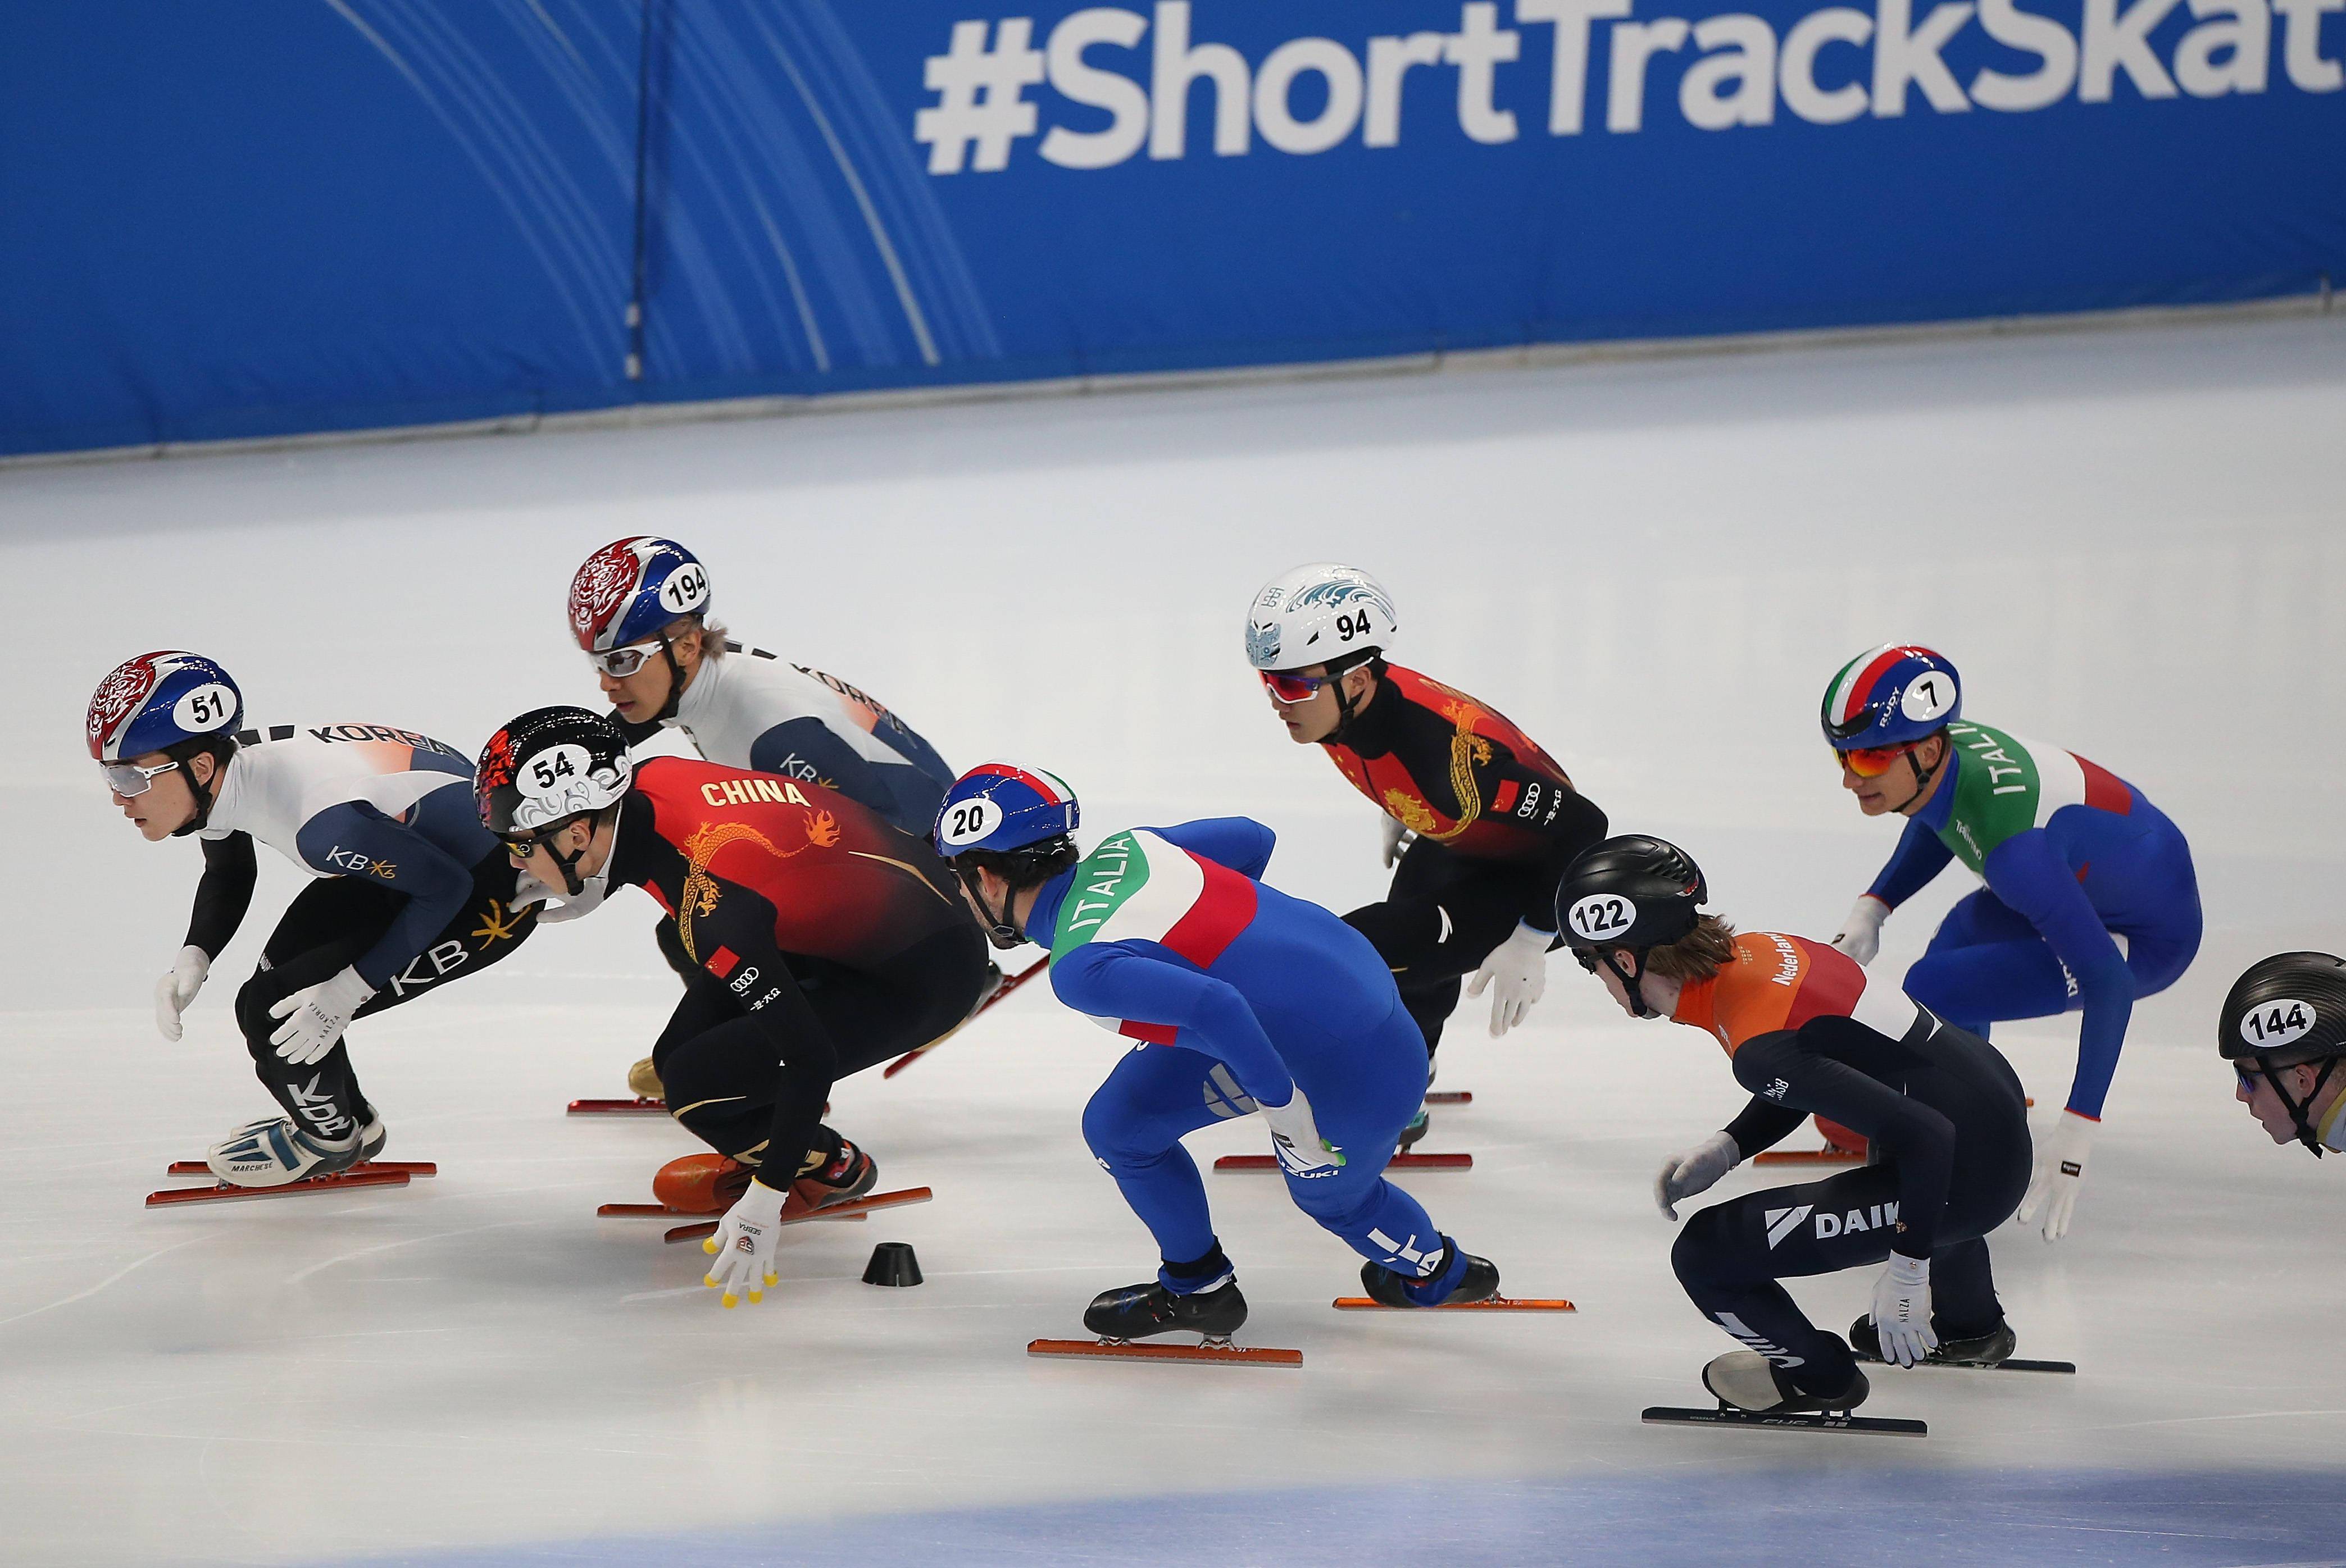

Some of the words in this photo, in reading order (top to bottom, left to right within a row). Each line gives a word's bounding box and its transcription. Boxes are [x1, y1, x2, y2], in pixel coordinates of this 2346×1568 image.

[915, 0, 2345, 174] #ShortTrackSkat
[669, 567, 706, 607] 194
[1336, 609, 1371, 641] 94
[192, 691, 224, 723] 51
[1879, 686, 1899, 727] RUDY
[1920, 681, 1938, 708] 7
[307, 724, 466, 765] KOREA
[533, 751, 575, 788] 54
[701, 779, 812, 807] CHINA
[952, 805, 984, 837] 20
[1068, 837, 1131, 932] ITALIA
[1575, 899, 1629, 933] 122
[308, 1002, 330, 1024] KOREA
[2249, 1004, 2307, 1041] 144
[287, 1071, 351, 1136] KOR
[231, 1162, 273, 1172] MARCHESE
[739, 1222, 762, 1236] SEBRA
[1898, 1298, 1910, 1323] NALZA
